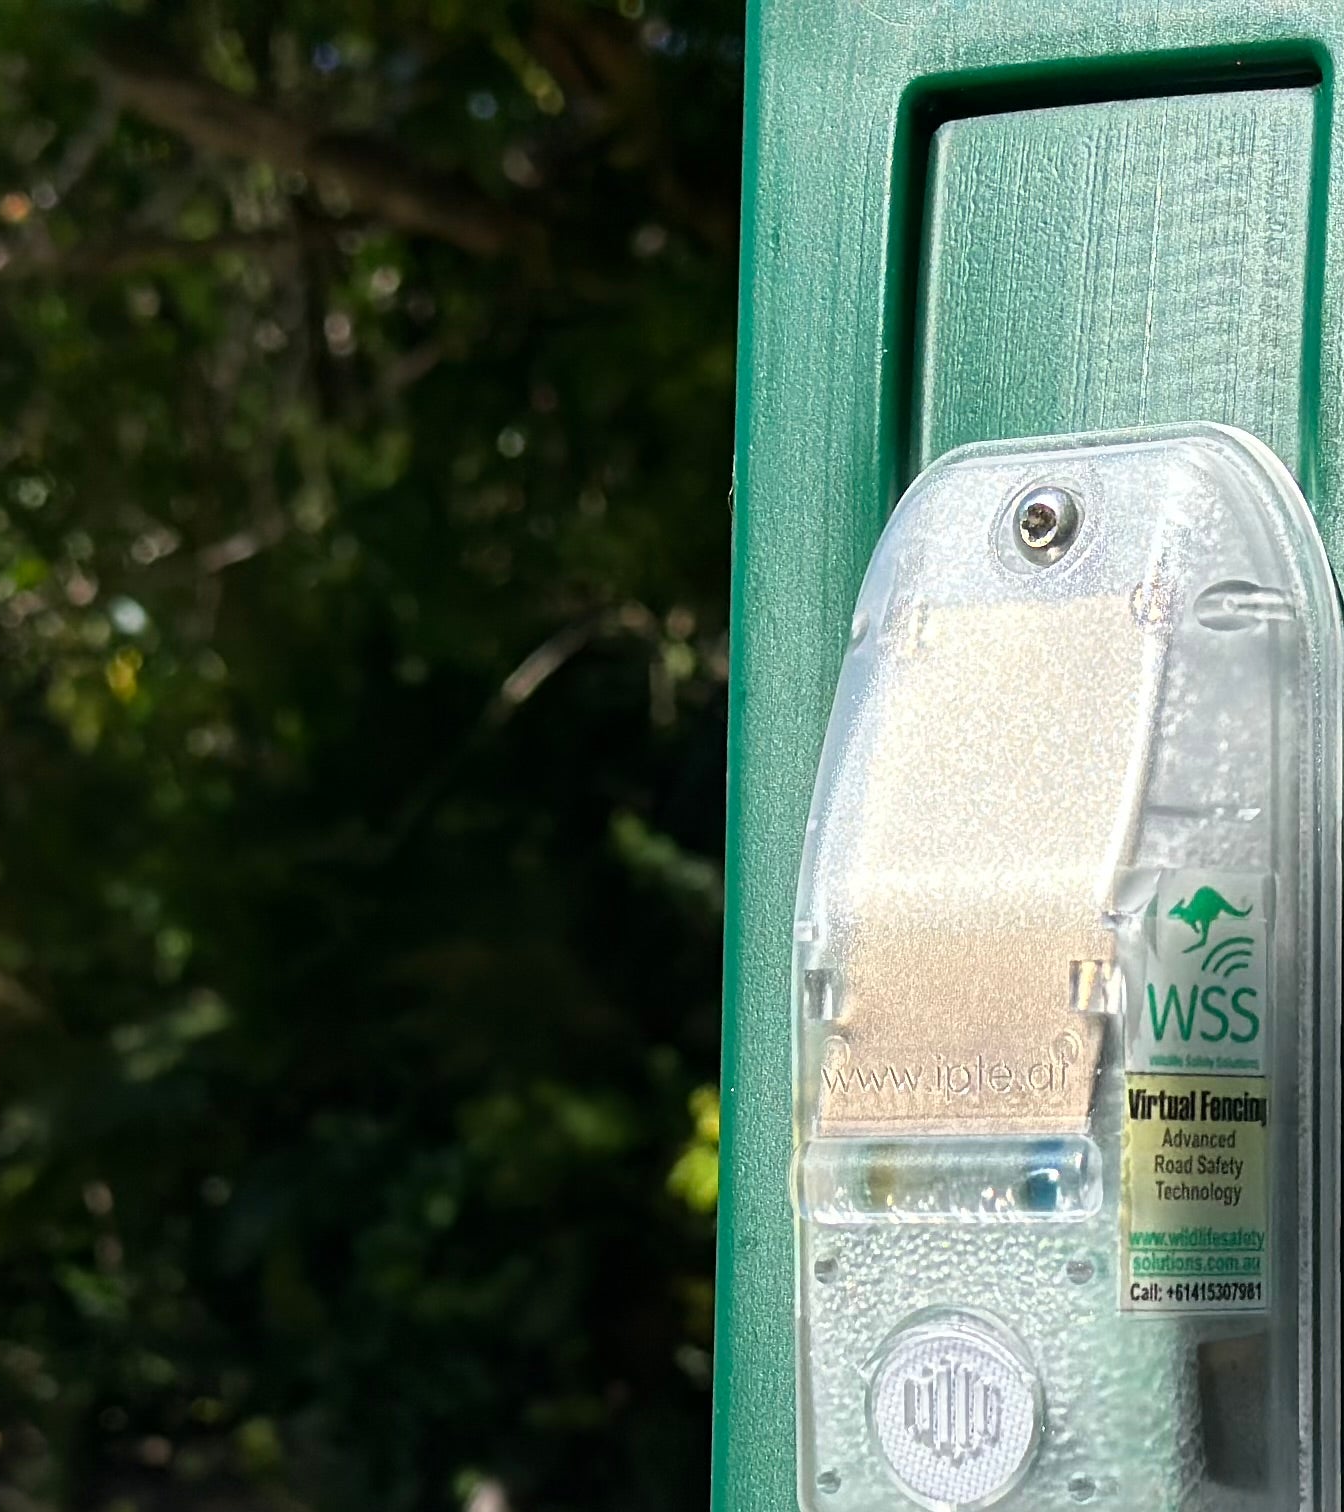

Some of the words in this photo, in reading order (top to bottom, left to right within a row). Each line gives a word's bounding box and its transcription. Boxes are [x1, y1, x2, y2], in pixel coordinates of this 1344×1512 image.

[1148, 983, 1260, 1042] WSS
[1128, 1089, 1195, 1121] Virtual
[1200, 1090, 1267, 1127] Fencing
[1162, 1128, 1235, 1148] Advanced
[1155, 1155, 1192, 1174] Road
[1197, 1156, 1243, 1180] Safety
[1156, 1181, 1242, 1206] Technology
